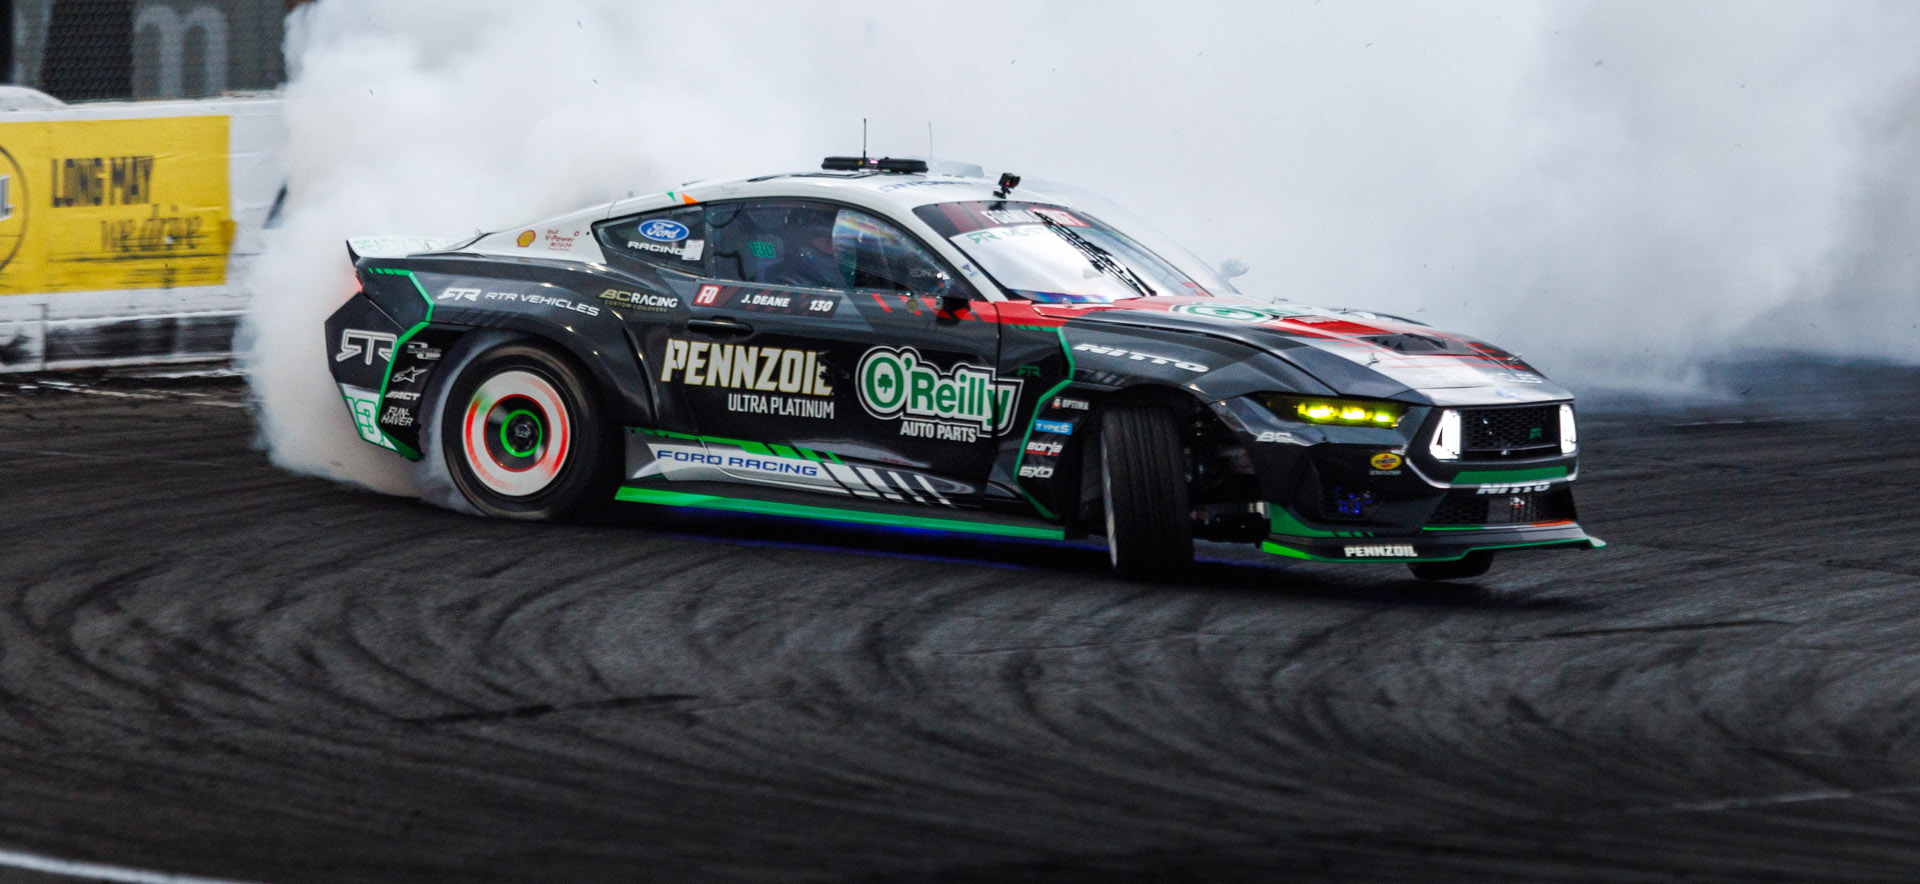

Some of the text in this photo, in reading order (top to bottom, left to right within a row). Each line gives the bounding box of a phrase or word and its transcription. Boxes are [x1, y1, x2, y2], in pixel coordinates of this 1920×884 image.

[52, 159, 104, 207] LONG
[110, 157, 153, 205] MAY
[646, 222, 681, 239] Ford
[627, 241, 688, 257] RACING
[485, 291, 519, 301] RTR
[520, 293, 600, 317] VEHICLES
[741, 294, 791, 308] J. DEANE
[808, 300, 833, 312] 130
[661, 338, 834, 396] PENNZOIL
[1072, 343, 1209, 373] NITTO
[863, 353, 1012, 428] O'Reilly
[728, 393, 834, 419] ULTRA PLATINUM
[381, 415, 413, 427] HAVER
[900, 420, 977, 443] AUTO PARTS
[657, 449, 818, 477] FORD RACING
[1476, 481, 1551, 495] NITTO
[1344, 544, 1418, 558] PENNZOIL
